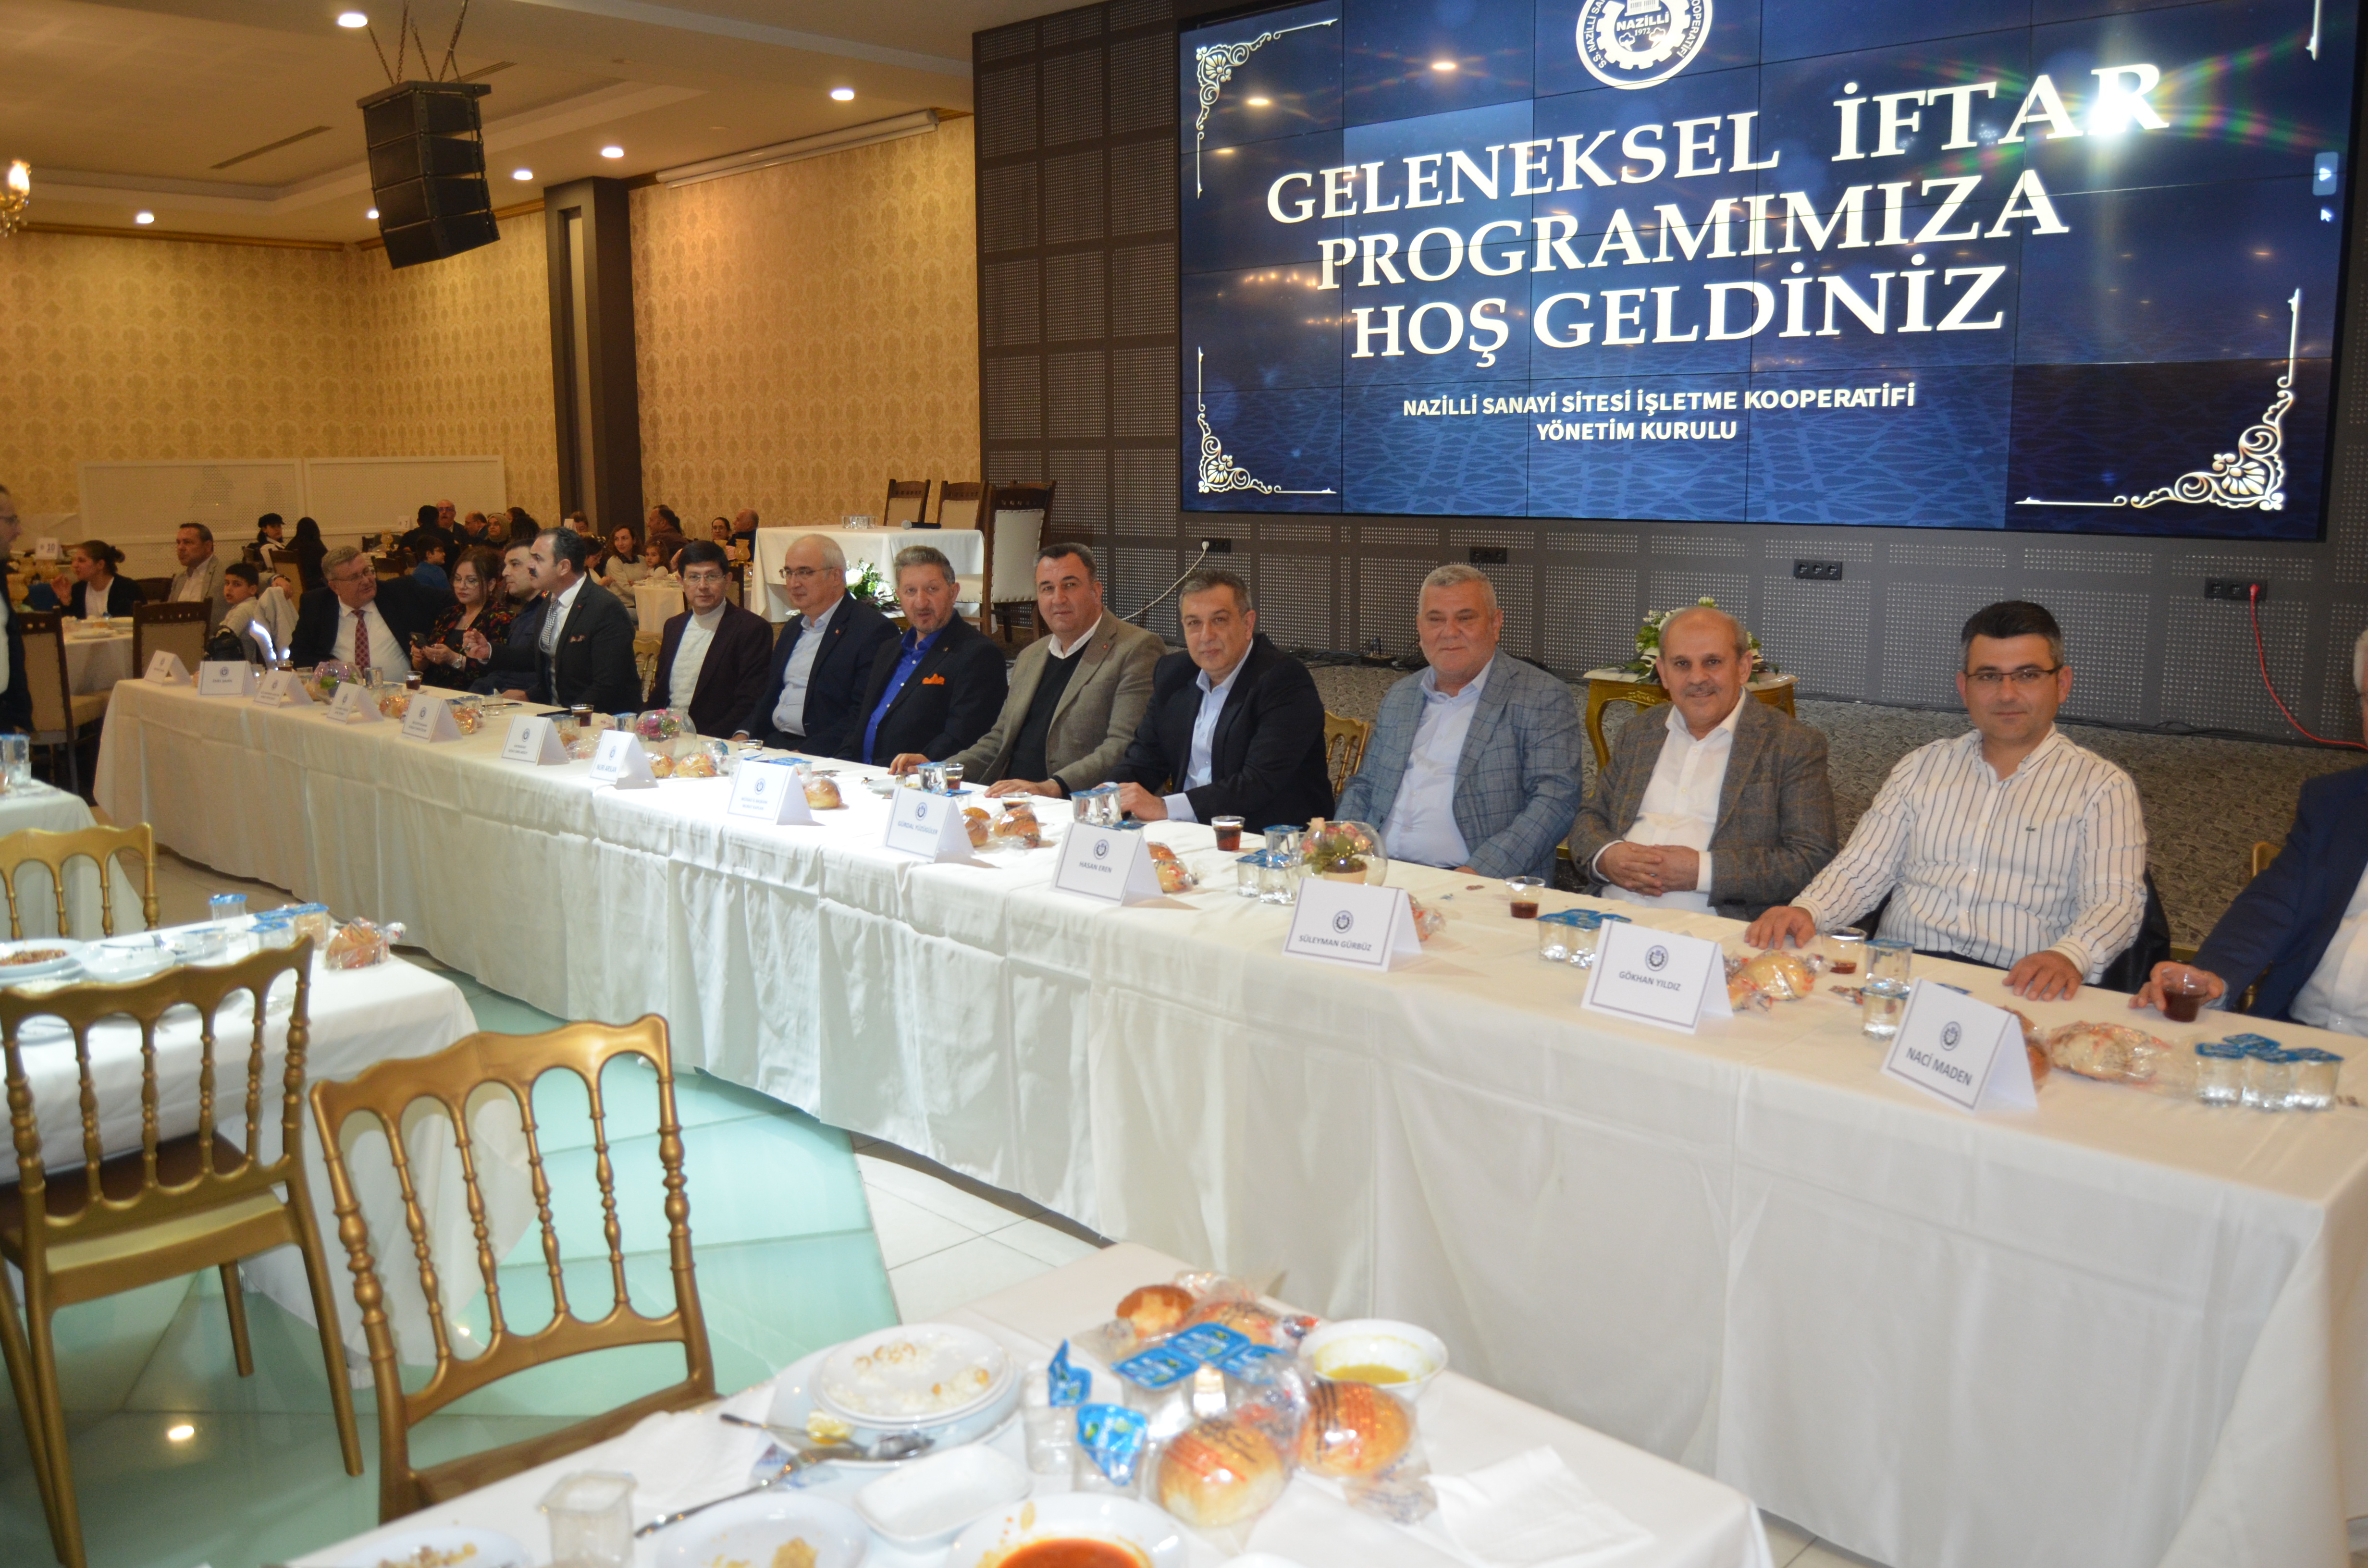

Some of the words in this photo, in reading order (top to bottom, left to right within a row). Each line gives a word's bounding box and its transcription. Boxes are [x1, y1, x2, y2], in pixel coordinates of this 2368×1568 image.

[1584, 16, 1597, 53] NAZİLLİ
[1616, 11, 1669, 31] NAZİLLİ
[1634, 27, 1651, 36] 1972
[1676, 0, 1702, 58] OOPERATİFİ
[1268, 111, 1779, 223] GELENEKSEL
[1832, 63, 2170, 161] İFTAR
[1317, 170, 2069, 290] PROGRAMIMIZA
[1351, 298, 1508, 367] HOŞ
[1534, 254, 2005, 348] GELDİNİZ
[1404, 393, 1477, 416] NAZİLLİ
[1482, 392, 1556, 414] SANAYİ
[1561, 389, 1631, 412] SİTESİ
[1637, 389, 1737, 416] İŞLETME
[1745, 382, 1915, 409] KOOPERATİFİ
[1536, 418, 1635, 441] YÖNETİM
[1641, 421, 1737, 440] KURULU
[1079, 861, 1097, 870] HASAN
[1098, 864, 1112, 873] EREN
[1299, 934, 1338, 947] SÜLEYMAN
[1340, 940, 1372, 952] GÜRBÜZ
[1619, 970, 1654, 985] GÖKHAN
[1656, 978, 1681, 991] YILDIZ
[1906, 1047, 1934, 1067] NACİ
[1932, 1058, 1973, 1086] MADEN
